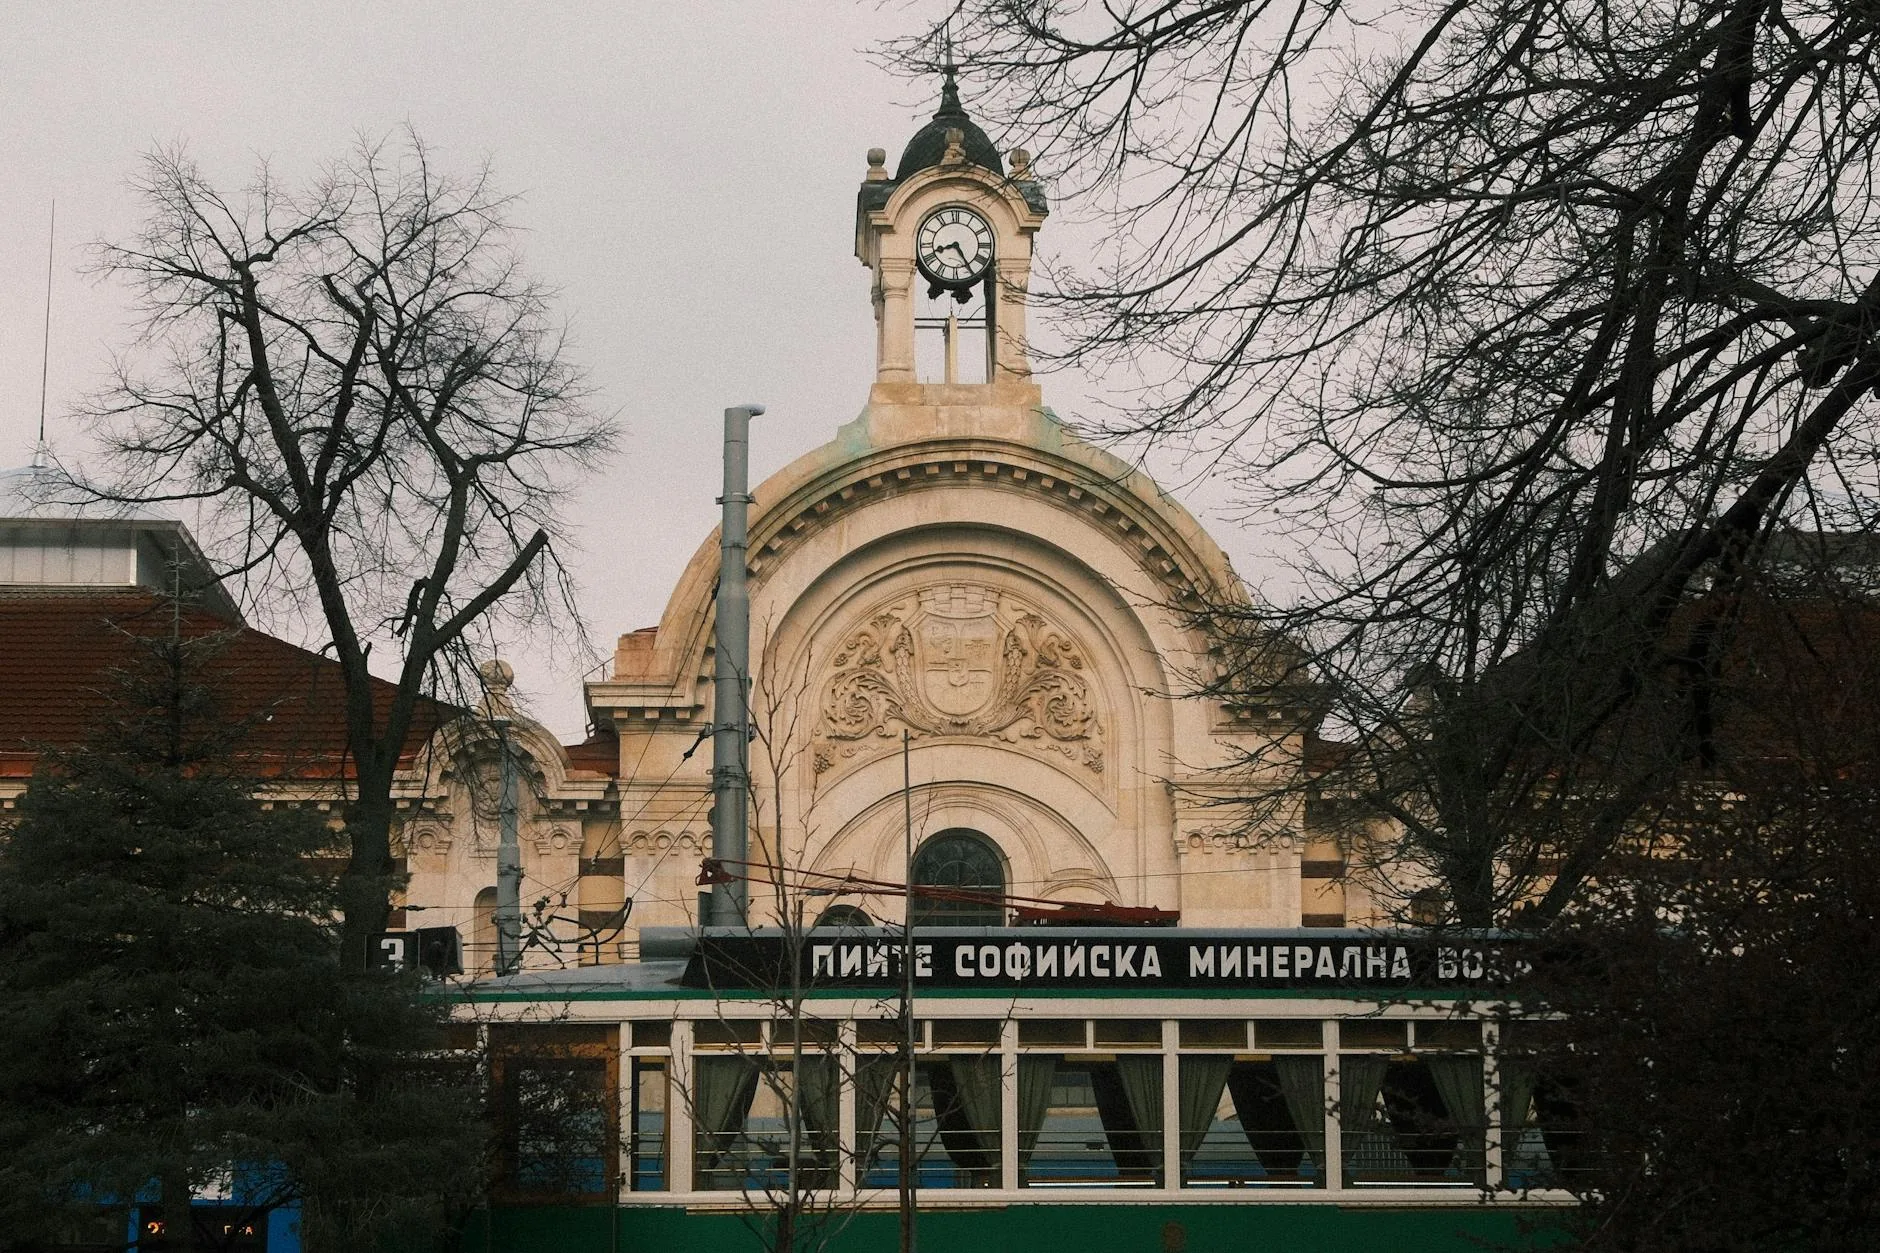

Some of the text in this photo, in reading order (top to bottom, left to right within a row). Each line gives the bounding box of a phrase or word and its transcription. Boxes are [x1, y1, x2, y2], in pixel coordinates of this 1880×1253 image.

[380, 938, 405, 973] 3
[955, 939, 1162, 980] СОФИЙСКА
[1189, 946, 1411, 978] МИНЕРАЛНА
